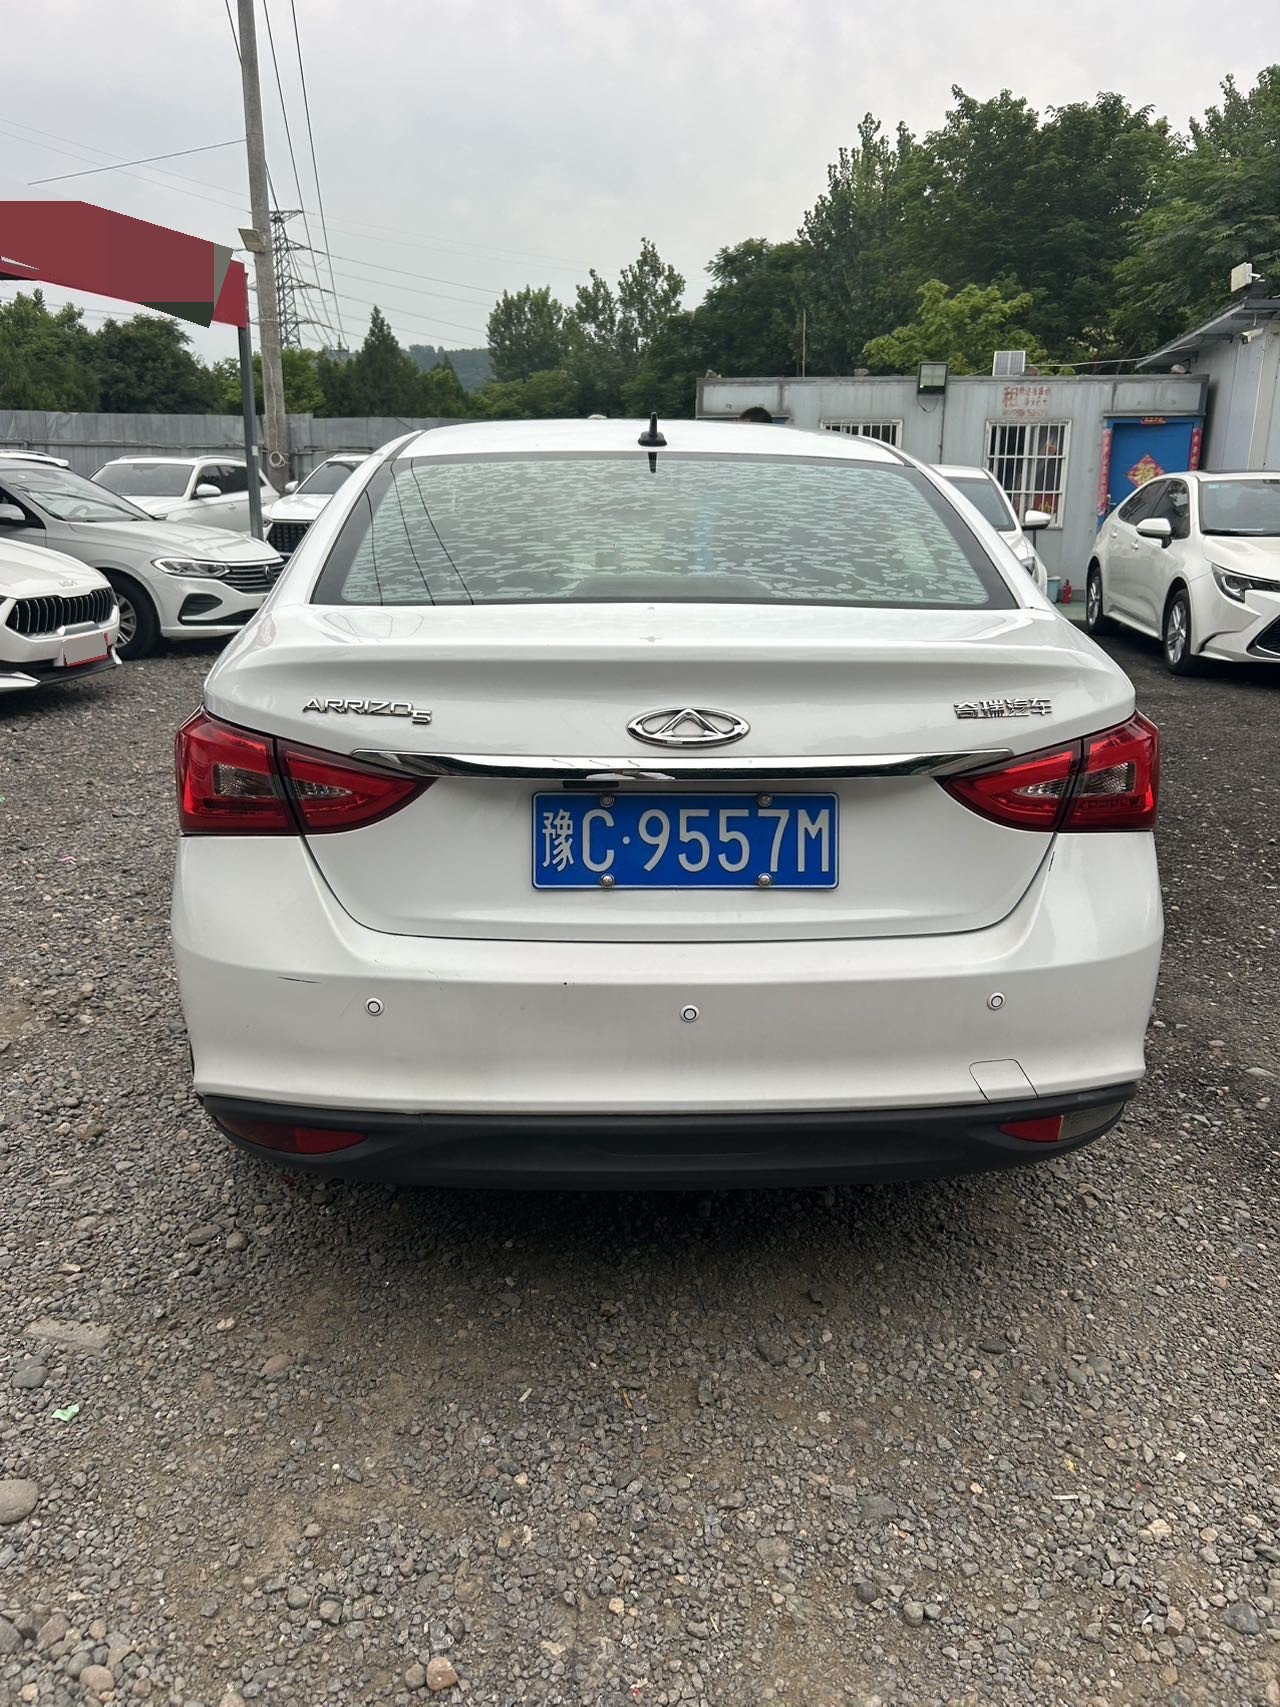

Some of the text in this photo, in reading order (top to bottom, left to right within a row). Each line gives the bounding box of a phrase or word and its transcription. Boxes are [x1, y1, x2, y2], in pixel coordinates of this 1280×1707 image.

[953, 697, 1053, 719] 奇瑞汽车
[541, 808, 830, 873] 豫C·9557M
